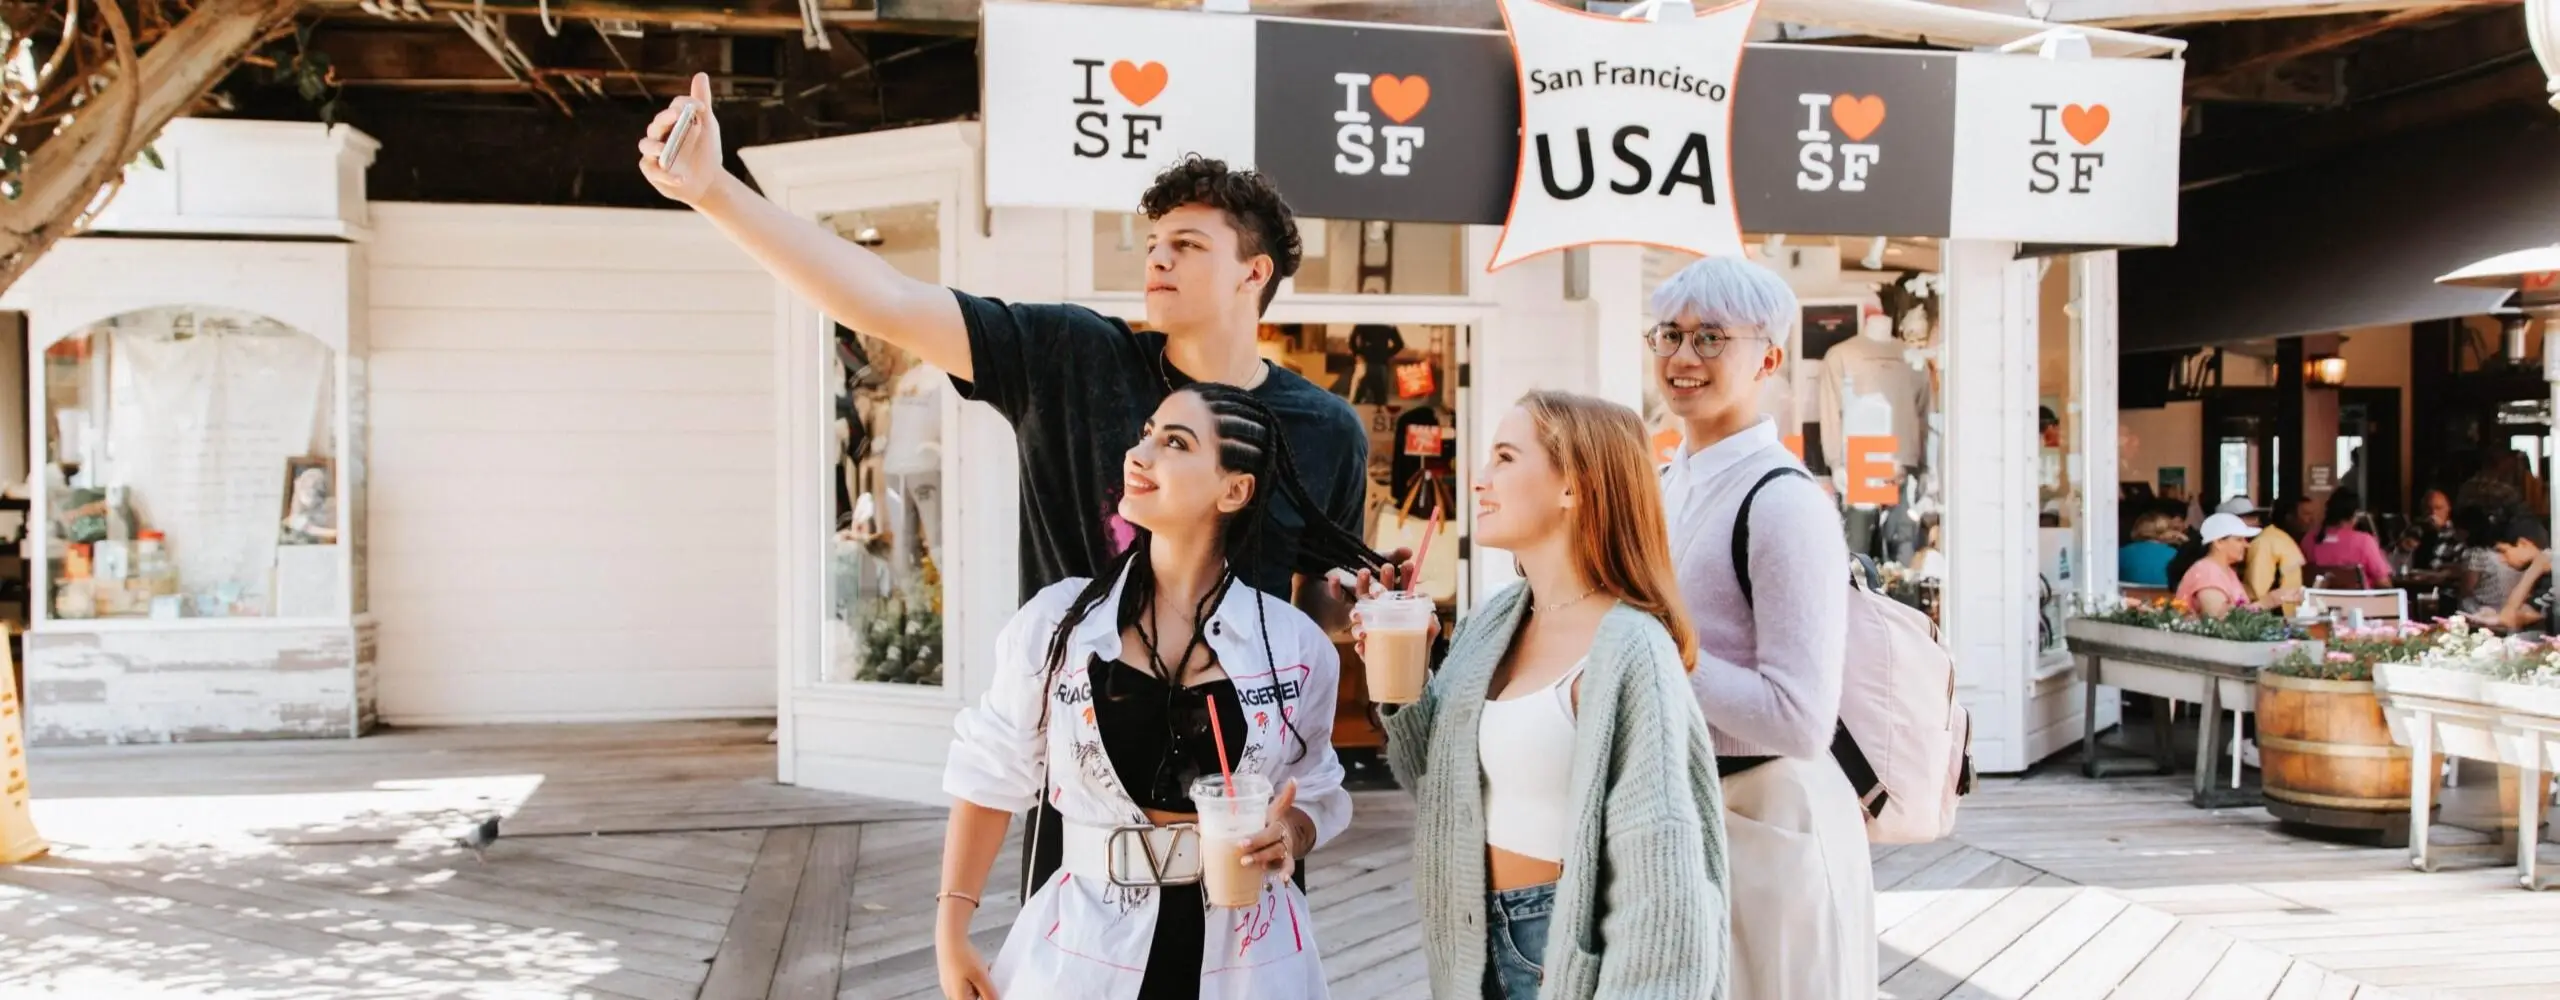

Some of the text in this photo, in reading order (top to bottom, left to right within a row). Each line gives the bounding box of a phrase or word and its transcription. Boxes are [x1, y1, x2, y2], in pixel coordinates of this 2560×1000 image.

[1073, 59, 1104, 105] I
[1334, 72, 1372, 124] I
[1530, 61, 1727, 102] San Francisco
[1073, 112, 1162, 160] SF
[1797, 93, 1833, 142] I
[2030, 104, 2058, 146] I
[1334, 124, 1425, 176] SF
[1535, 125, 1716, 206] USA
[1797, 143, 1880, 191] SF
[2029, 152, 2104, 194] SF
